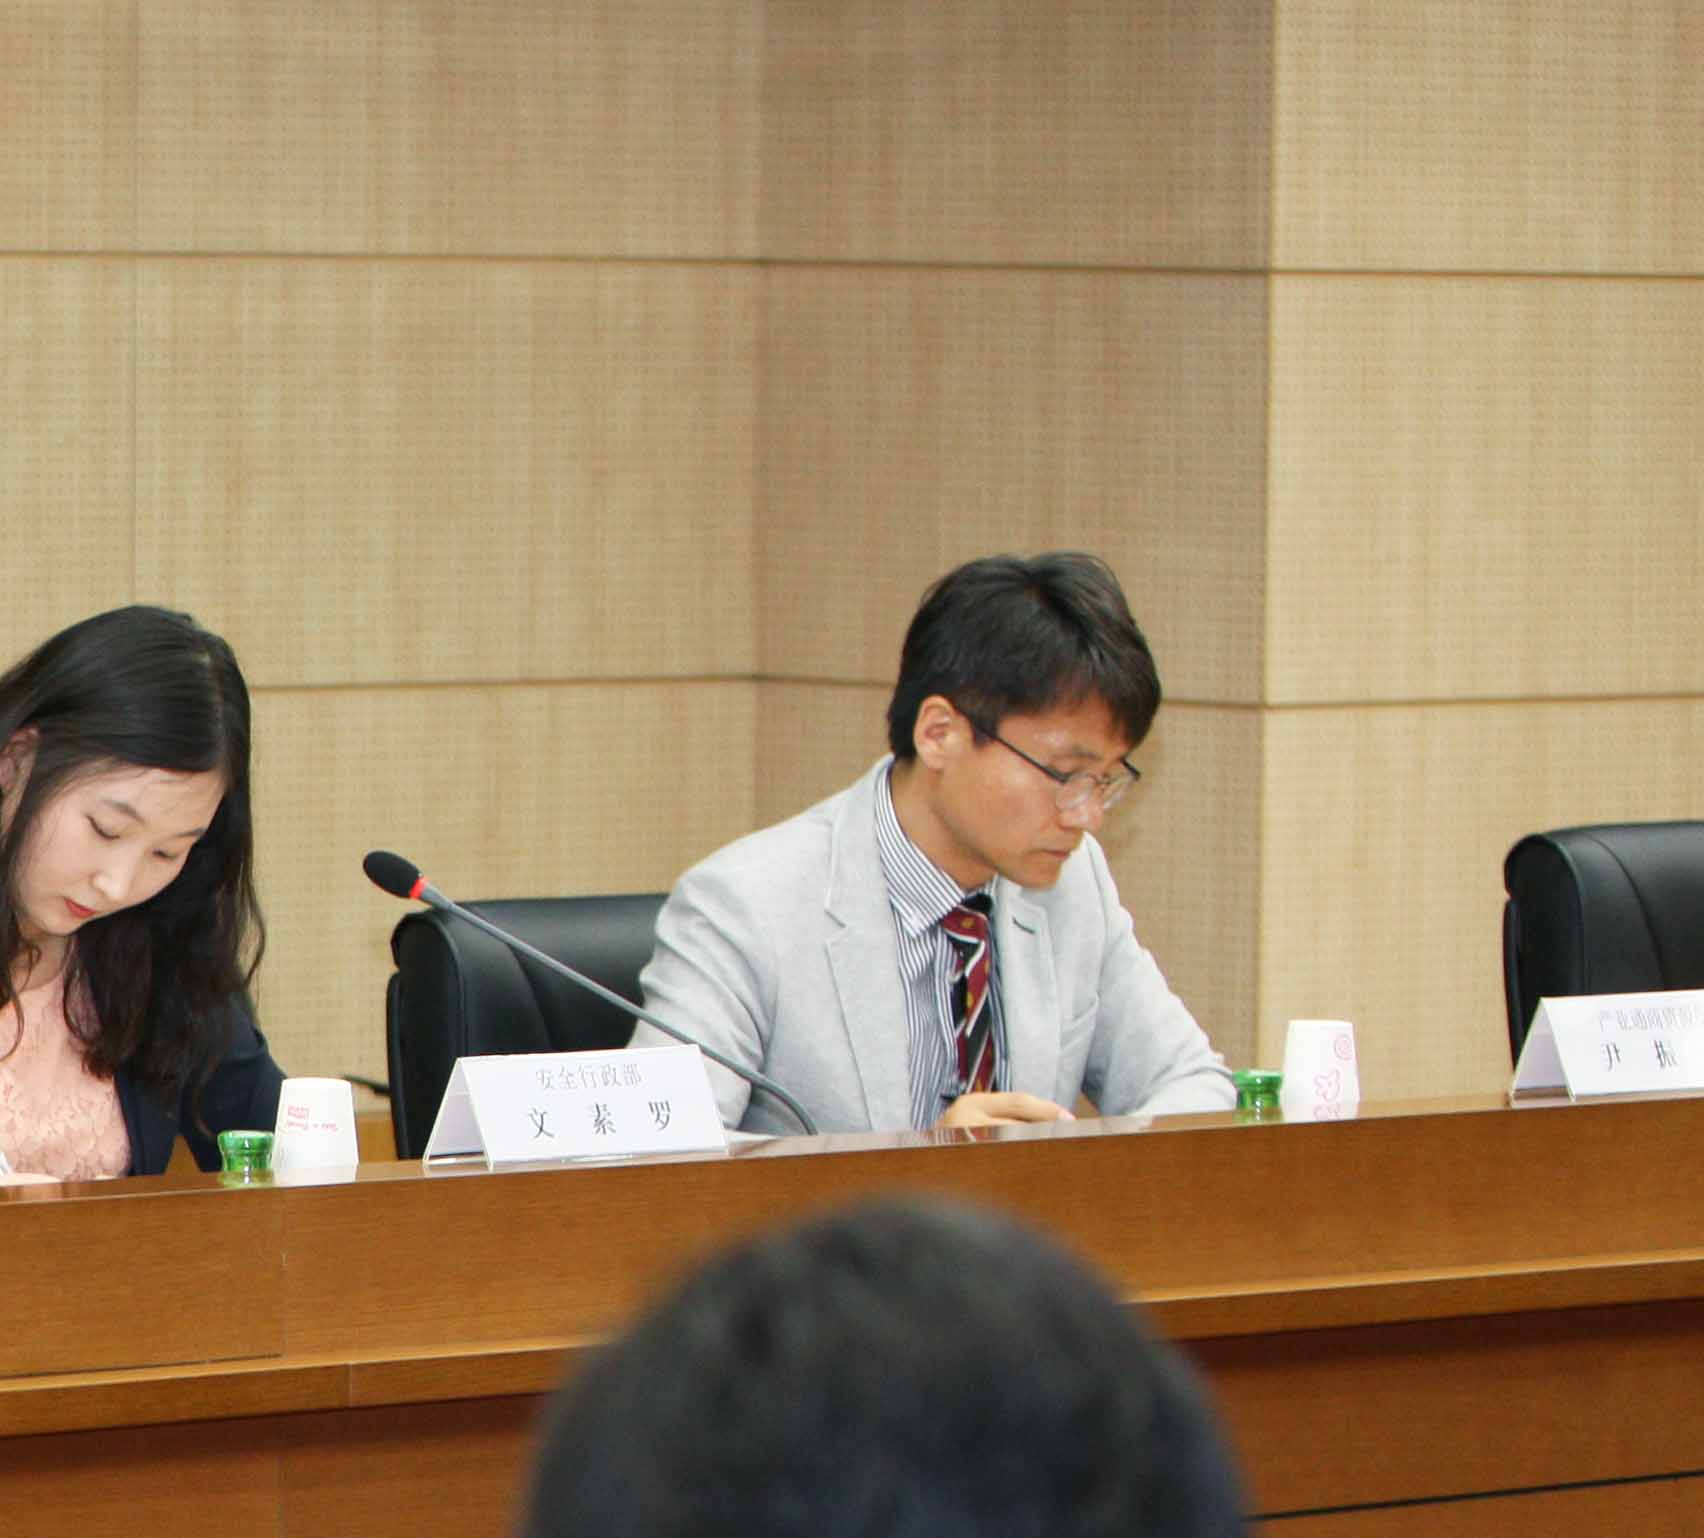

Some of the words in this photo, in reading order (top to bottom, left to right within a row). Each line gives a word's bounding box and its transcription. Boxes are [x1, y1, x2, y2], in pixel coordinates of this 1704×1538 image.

[536, 1064, 643, 1090] 安全行政部
